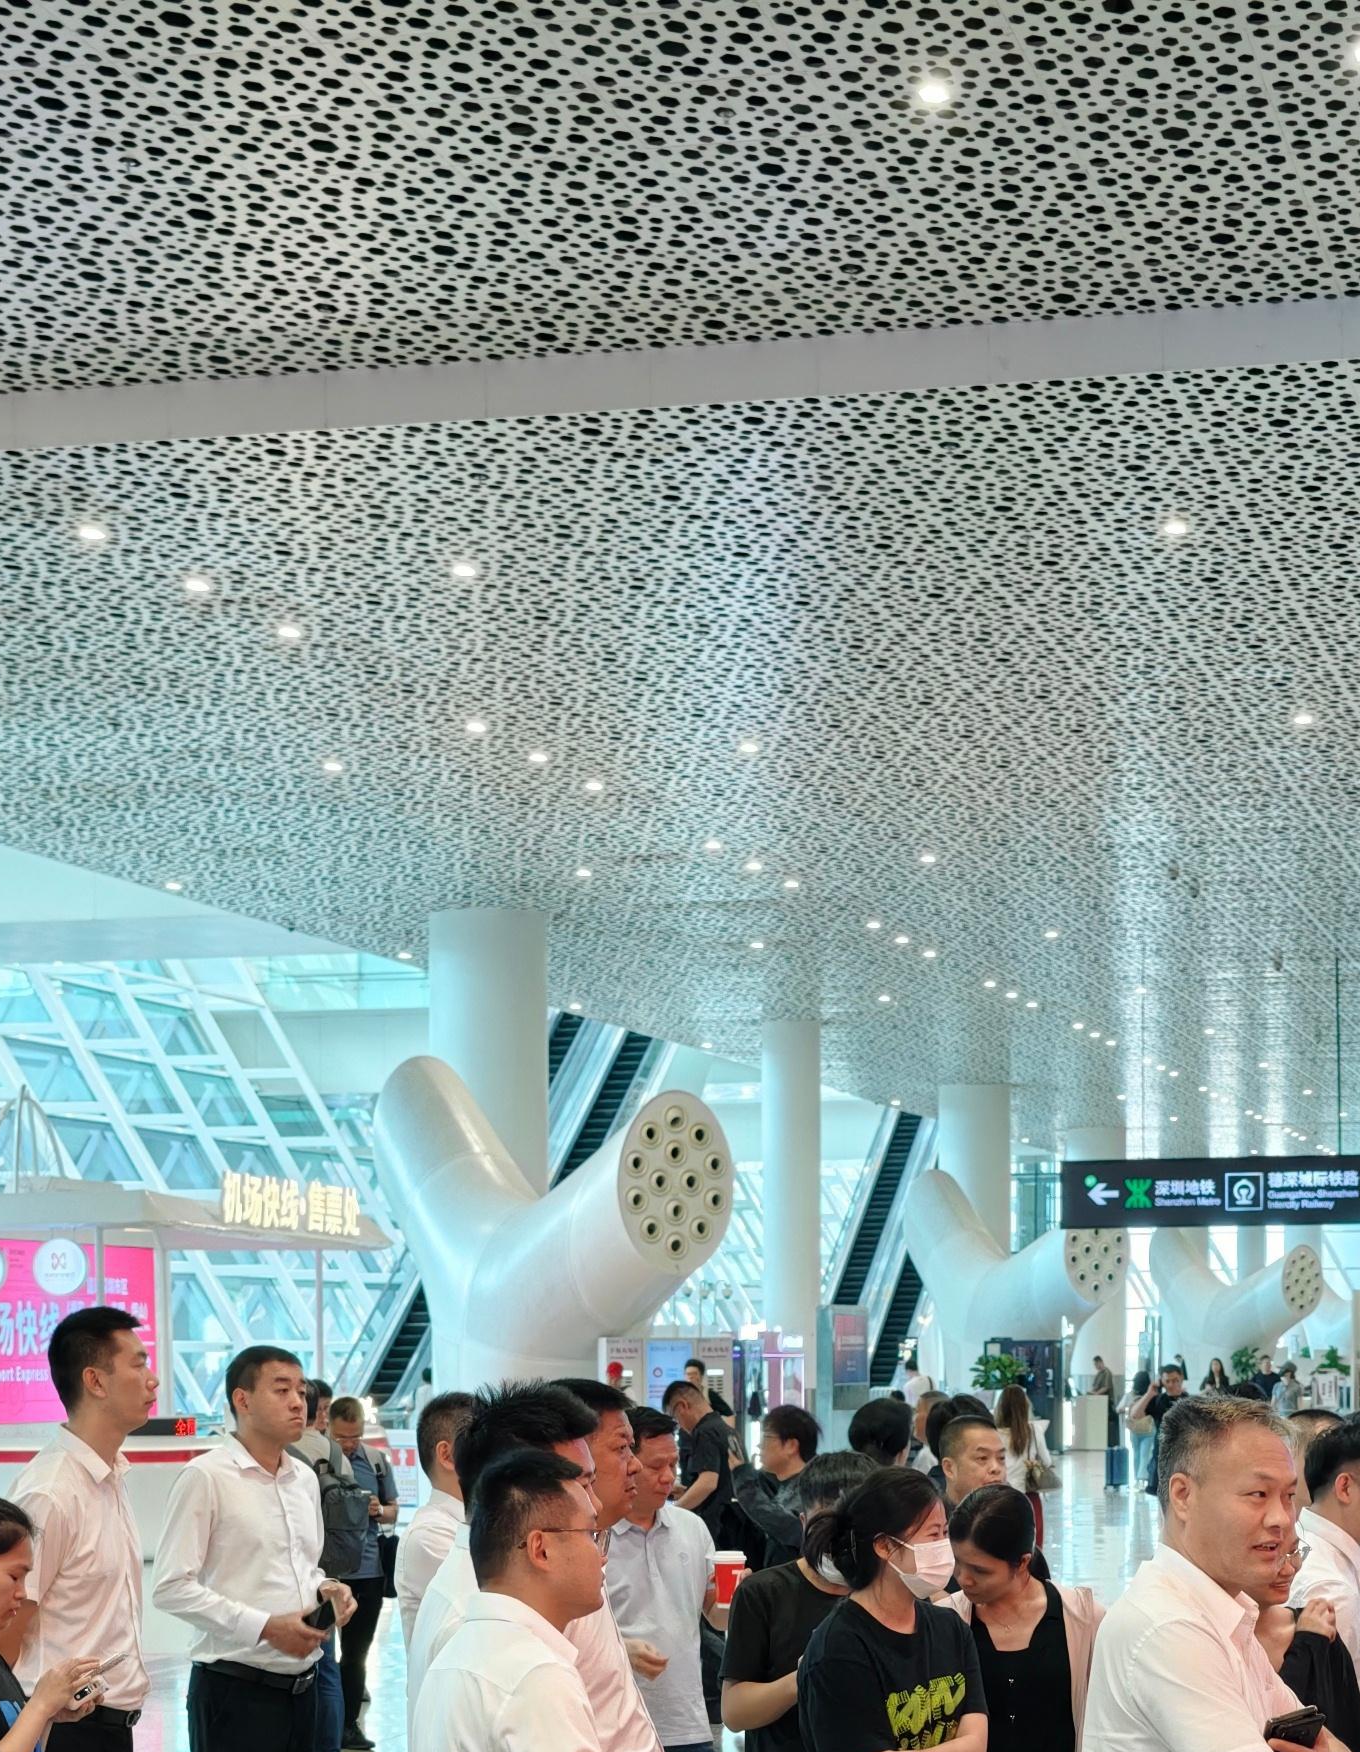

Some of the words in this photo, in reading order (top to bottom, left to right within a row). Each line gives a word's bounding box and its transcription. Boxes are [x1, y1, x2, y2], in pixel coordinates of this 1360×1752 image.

[1267, 1170, 1360, 1189] 穗深城际铁路
[1155, 1179, 1216, 1196] 深圳地铁
[1155, 1197, 1196, 1207] Shenzhen
[1197, 1196, 1222, 1206] Metro
[1267, 1189, 1360, 1201] Guangzhou-Shenzhen
[1267, 1200, 1299, 1211] Intercity
[1301, 1199, 1335, 1210] Railway
[16, 1366, 50, 1384] Express
